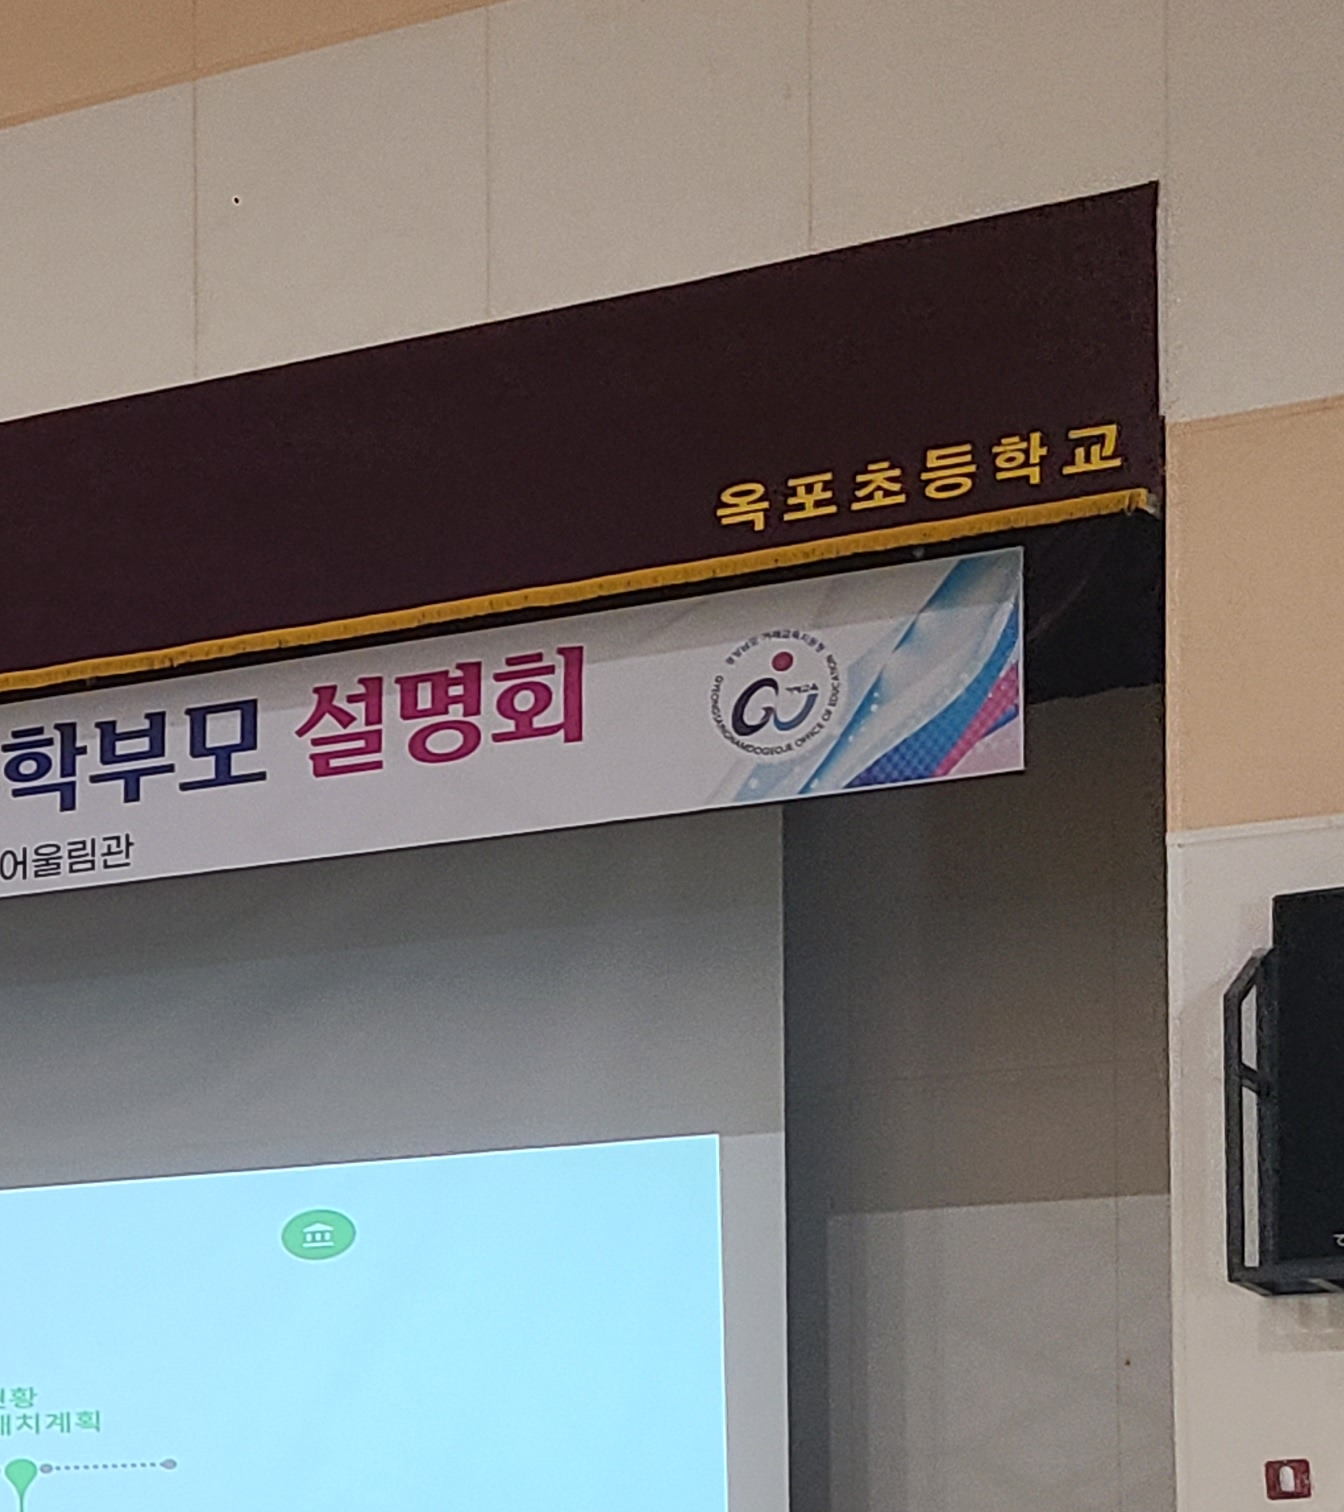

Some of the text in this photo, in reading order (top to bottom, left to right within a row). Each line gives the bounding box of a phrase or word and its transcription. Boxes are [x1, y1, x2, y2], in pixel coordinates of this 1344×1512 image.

[716, 423, 1123, 531] 옥포초등학교
[0, 699, 267, 812] 학부모
[295, 645, 586, 778] 설명회
[0, 832, 135, 882] 어울림관
